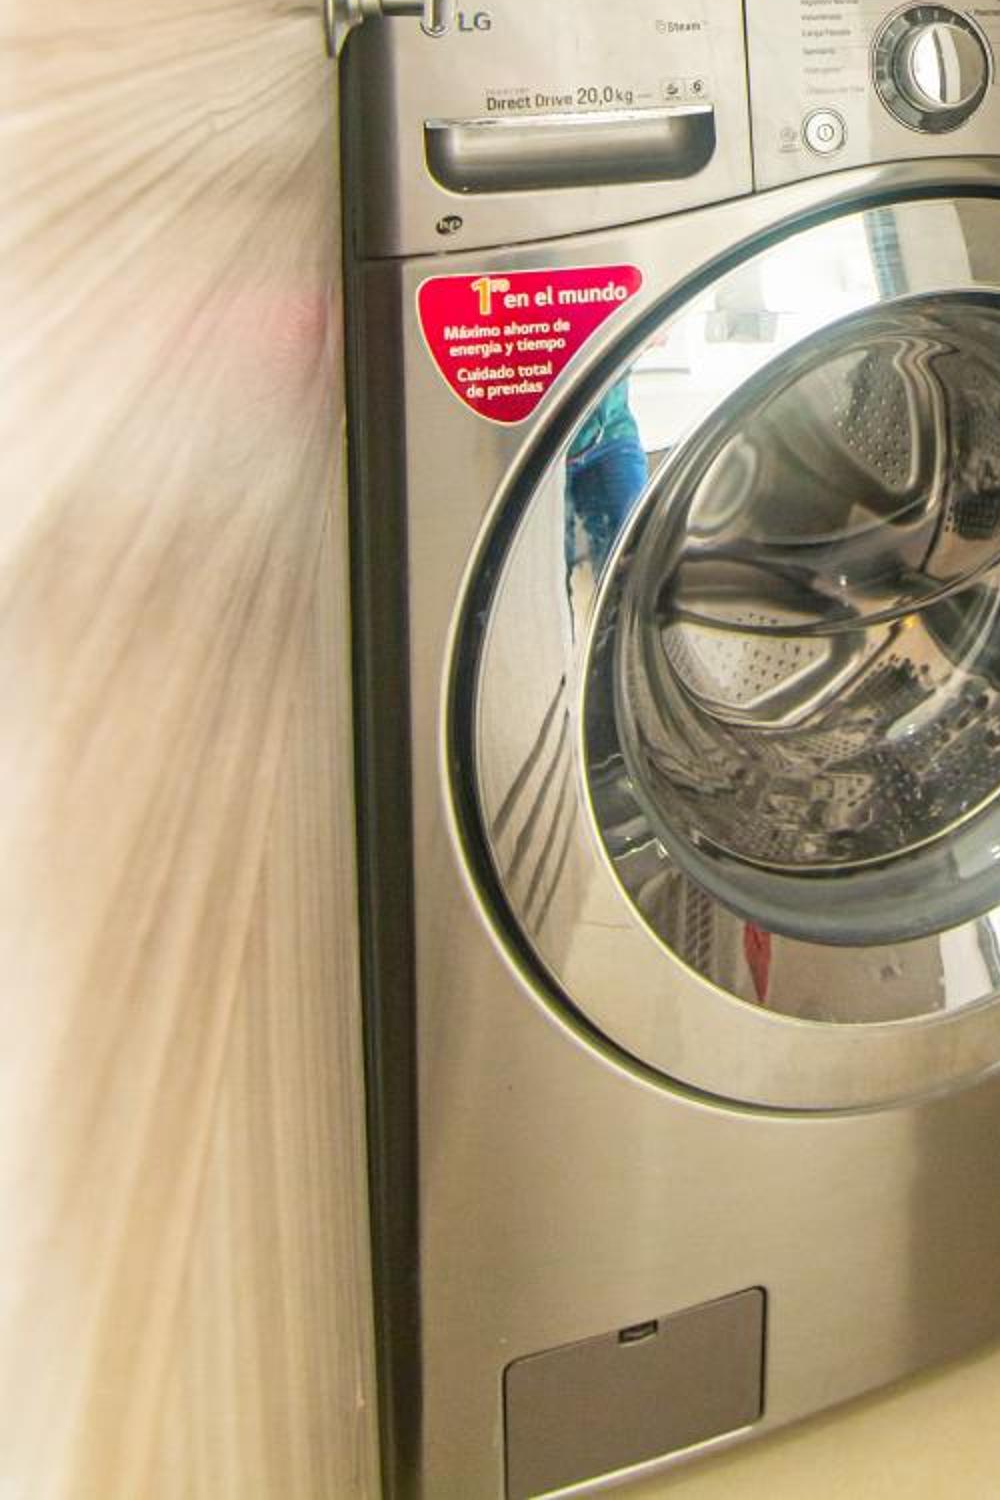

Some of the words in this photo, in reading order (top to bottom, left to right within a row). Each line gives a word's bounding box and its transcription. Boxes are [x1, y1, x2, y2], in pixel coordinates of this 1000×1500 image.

[457, 10, 492, 32] LG
[486, 96, 531, 111] Direct
[535, 93, 573, 108] Drive
[503, 292, 529, 309] en
[535, 286, 553, 306] el
[558, 283, 628, 305] mundo
[443, 323, 500, 341] Máximo
[503, 320, 548, 337] ahorro
[553, 318, 571, 332] de
[504, 342, 514, 356] y
[516, 336, 567, 353] tiempo
[456, 364, 515, 382] Cuidado
[518, 360, 553, 378] total
[466, 384, 484, 398] de
[487, 379, 544, 400] prendas
